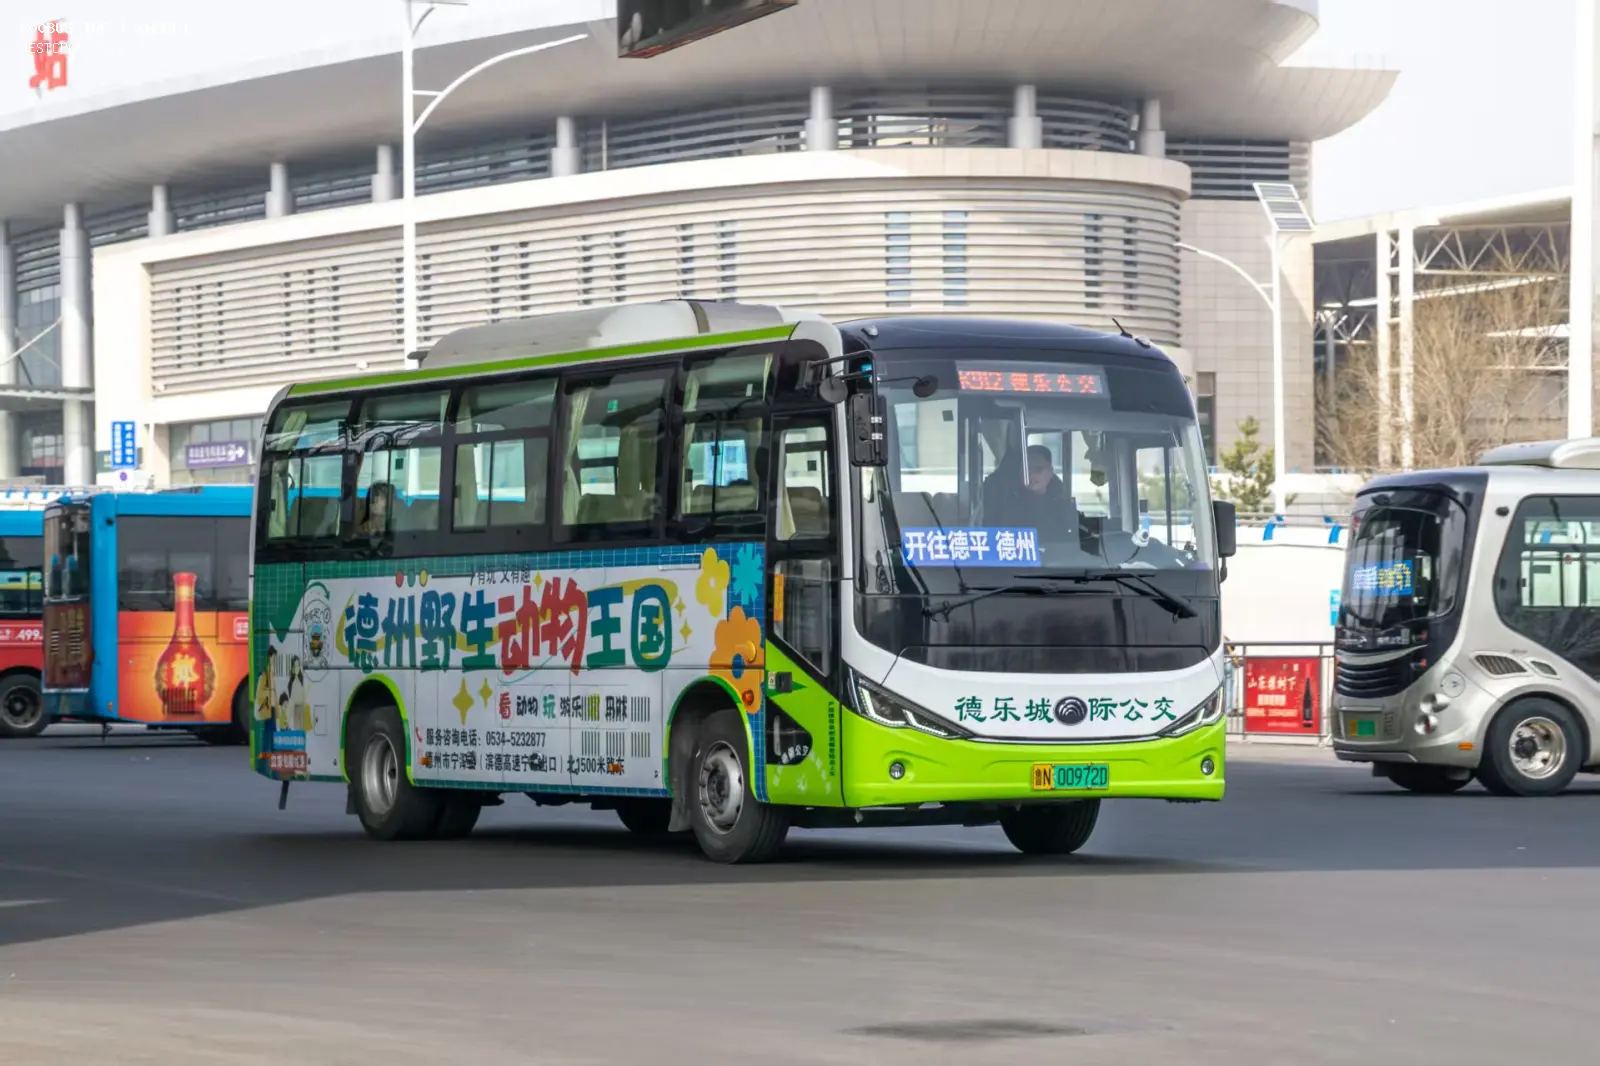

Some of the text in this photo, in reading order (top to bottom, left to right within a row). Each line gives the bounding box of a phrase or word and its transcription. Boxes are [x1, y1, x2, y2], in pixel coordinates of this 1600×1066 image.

[904, 530, 1038, 561] 开往德平 德州
[345, 576, 673, 677] 德州野生动物王国
[485, 731, 547, 748] 0534-5232877
[1057, 767, 1108, 786] 00972D
